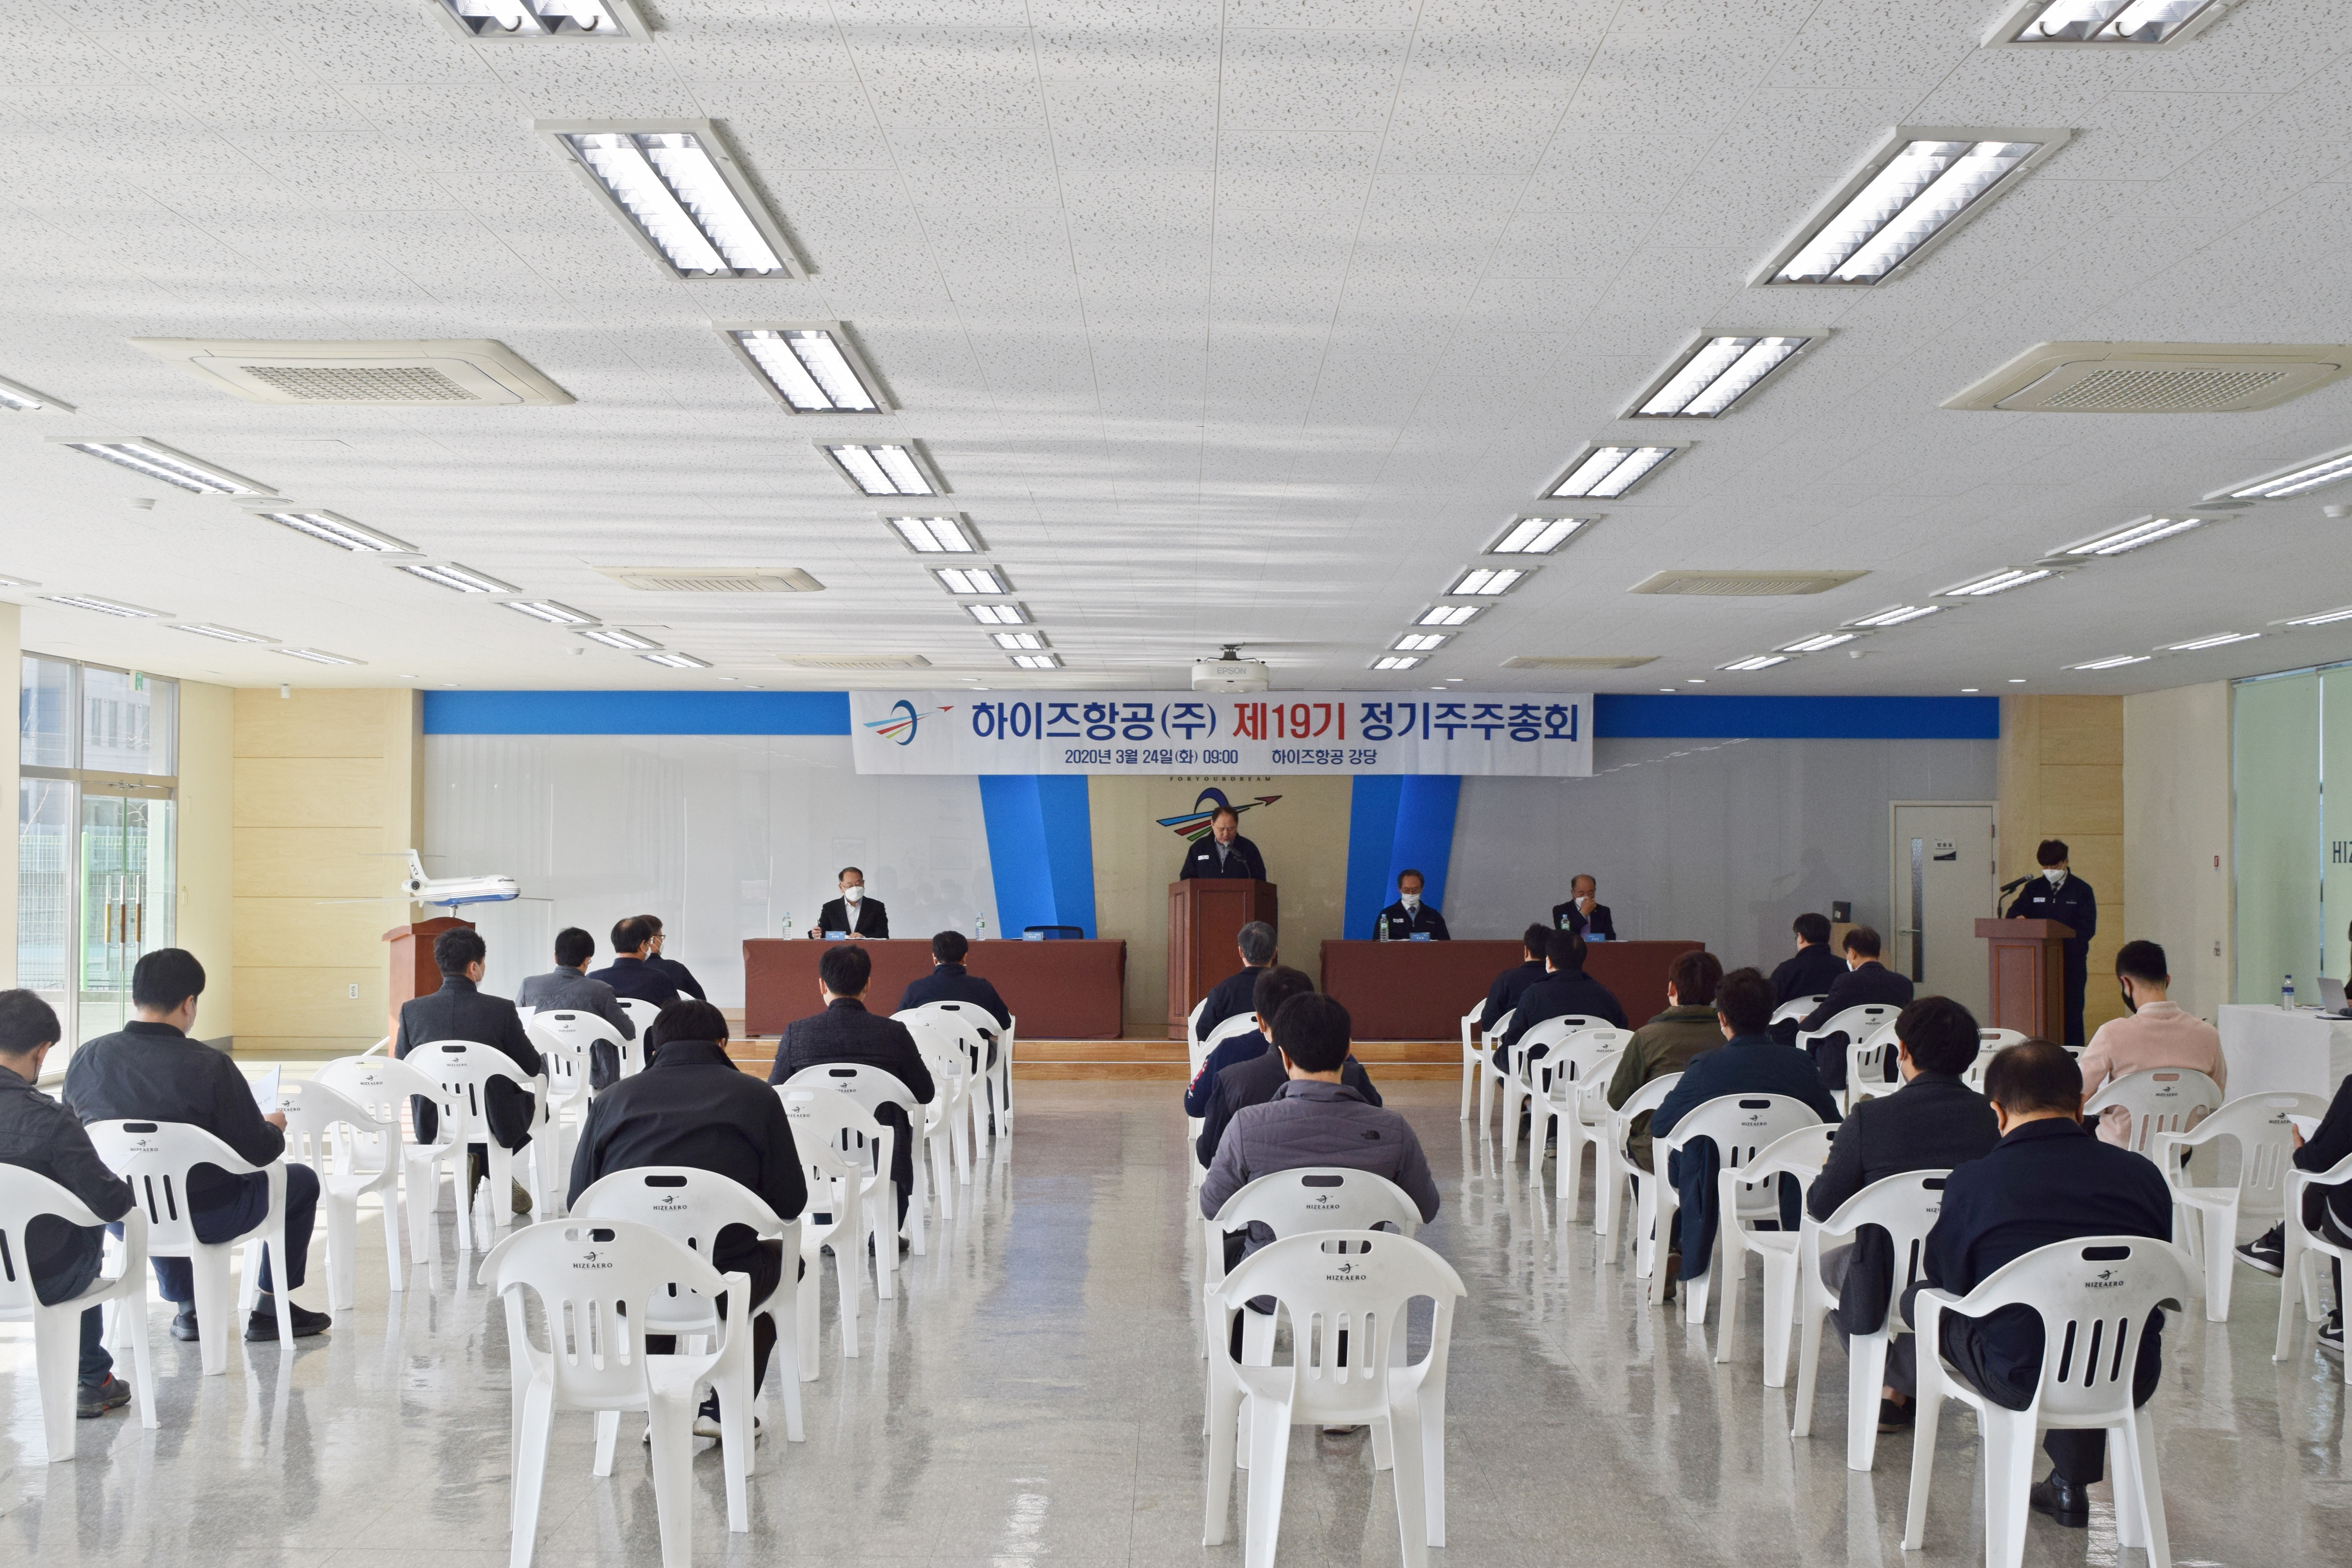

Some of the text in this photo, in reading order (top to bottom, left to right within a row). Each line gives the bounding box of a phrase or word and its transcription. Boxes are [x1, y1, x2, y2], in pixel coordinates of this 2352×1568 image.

[972, 702, 1578, 742] 하이즈항공(주) 제19기 정기주주총회
[1065, 749, 1377, 764] 2020년 3월 24일(화) 09:00 하이즈항공 강당
